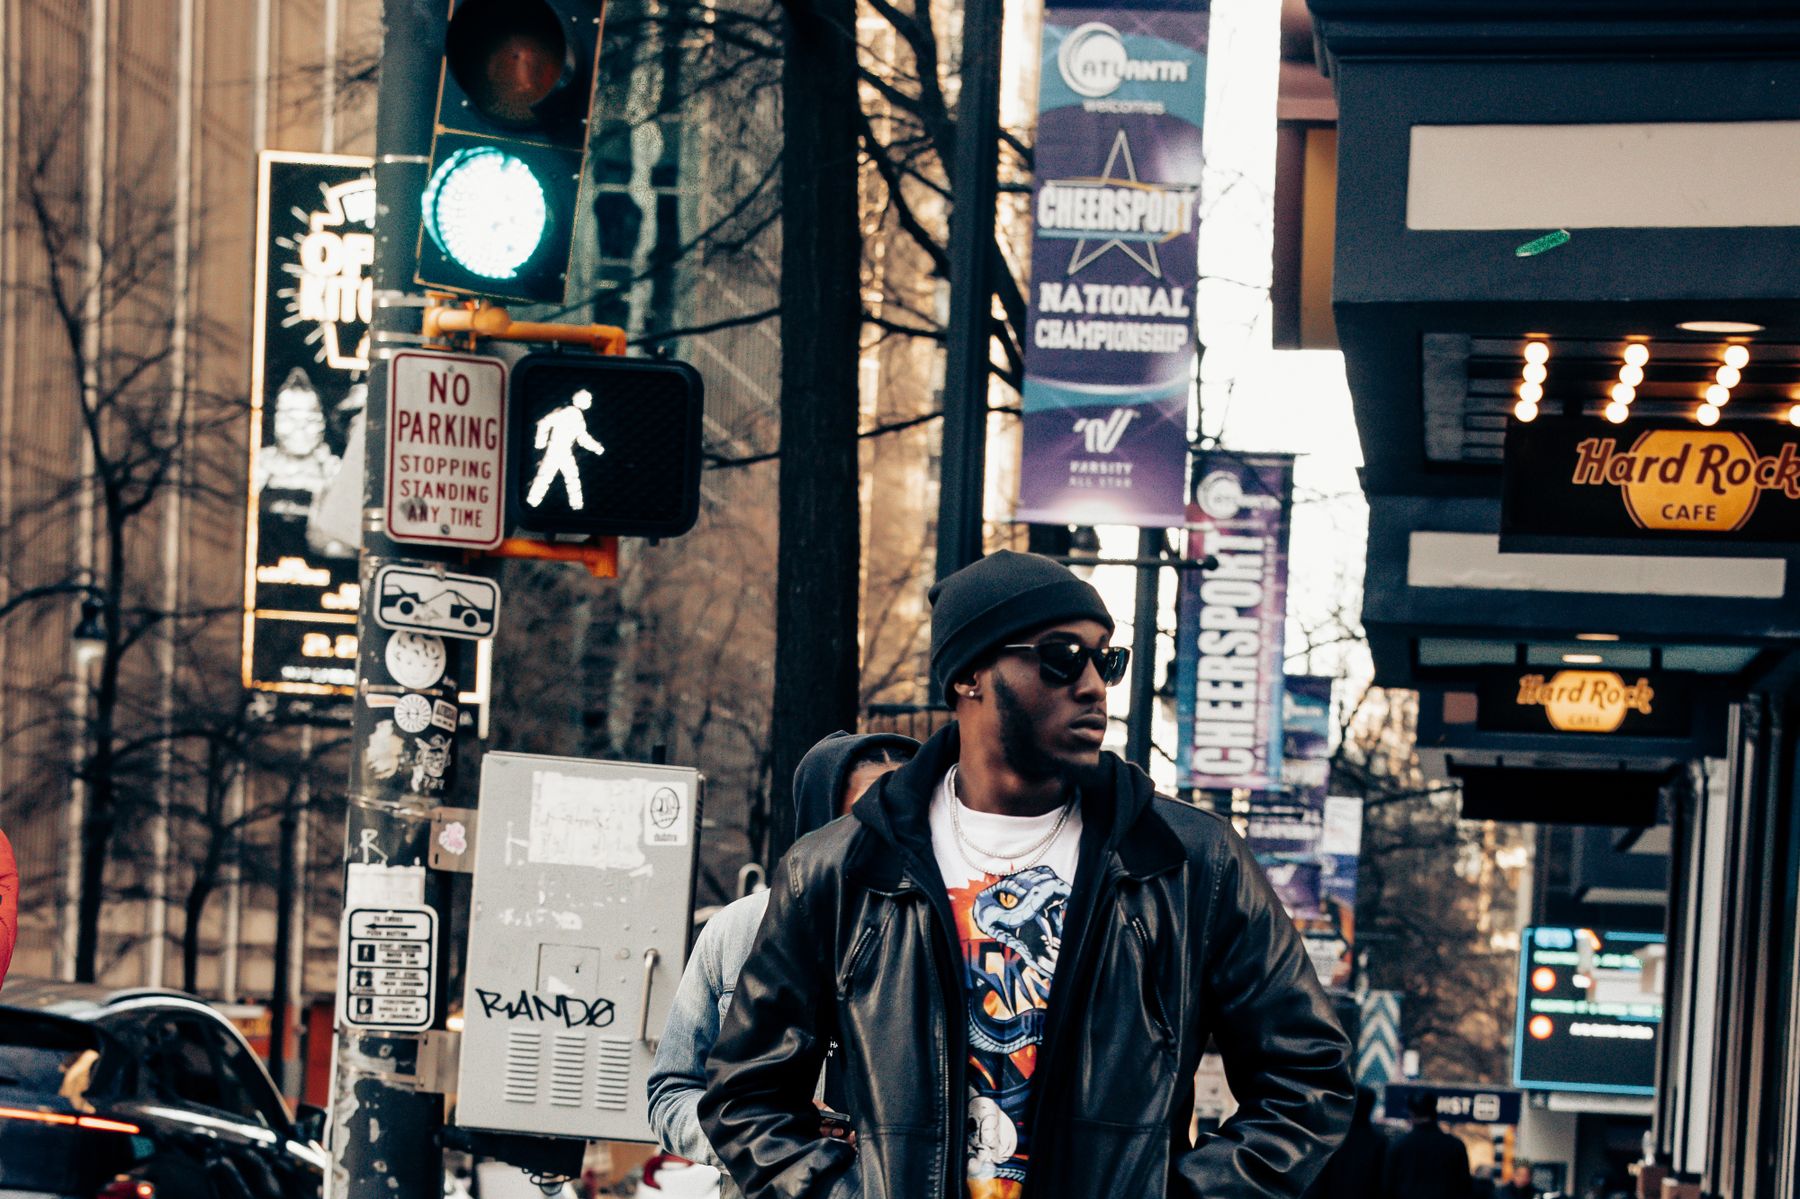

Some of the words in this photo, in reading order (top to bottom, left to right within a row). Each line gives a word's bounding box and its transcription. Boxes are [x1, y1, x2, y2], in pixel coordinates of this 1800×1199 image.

[1081, 58, 1189, 82] ATLANTA
[1037, 186, 1197, 233] CHEERSPORT
[1038, 282, 1190, 318] NATIONAL
[1034, 319, 1189, 352] CHAMPIONSHIP
[429, 371, 470, 406] NO
[398, 410, 498, 451] PARKING
[400, 454, 491, 480] STOPPING
[1572, 438, 1692, 485] Hard
[1695, 442, 1800, 499] Rock
[401, 479, 489, 504] STANDING
[407, 504, 440, 524] ANY
[450, 507, 483, 528] TIME
[1661, 503, 1717, 522] CAFE
[1192, 529, 1266, 776] CHEERSPORT
[1516, 674, 1586, 705] Hard
[1589, 677, 1655, 715] Rock
